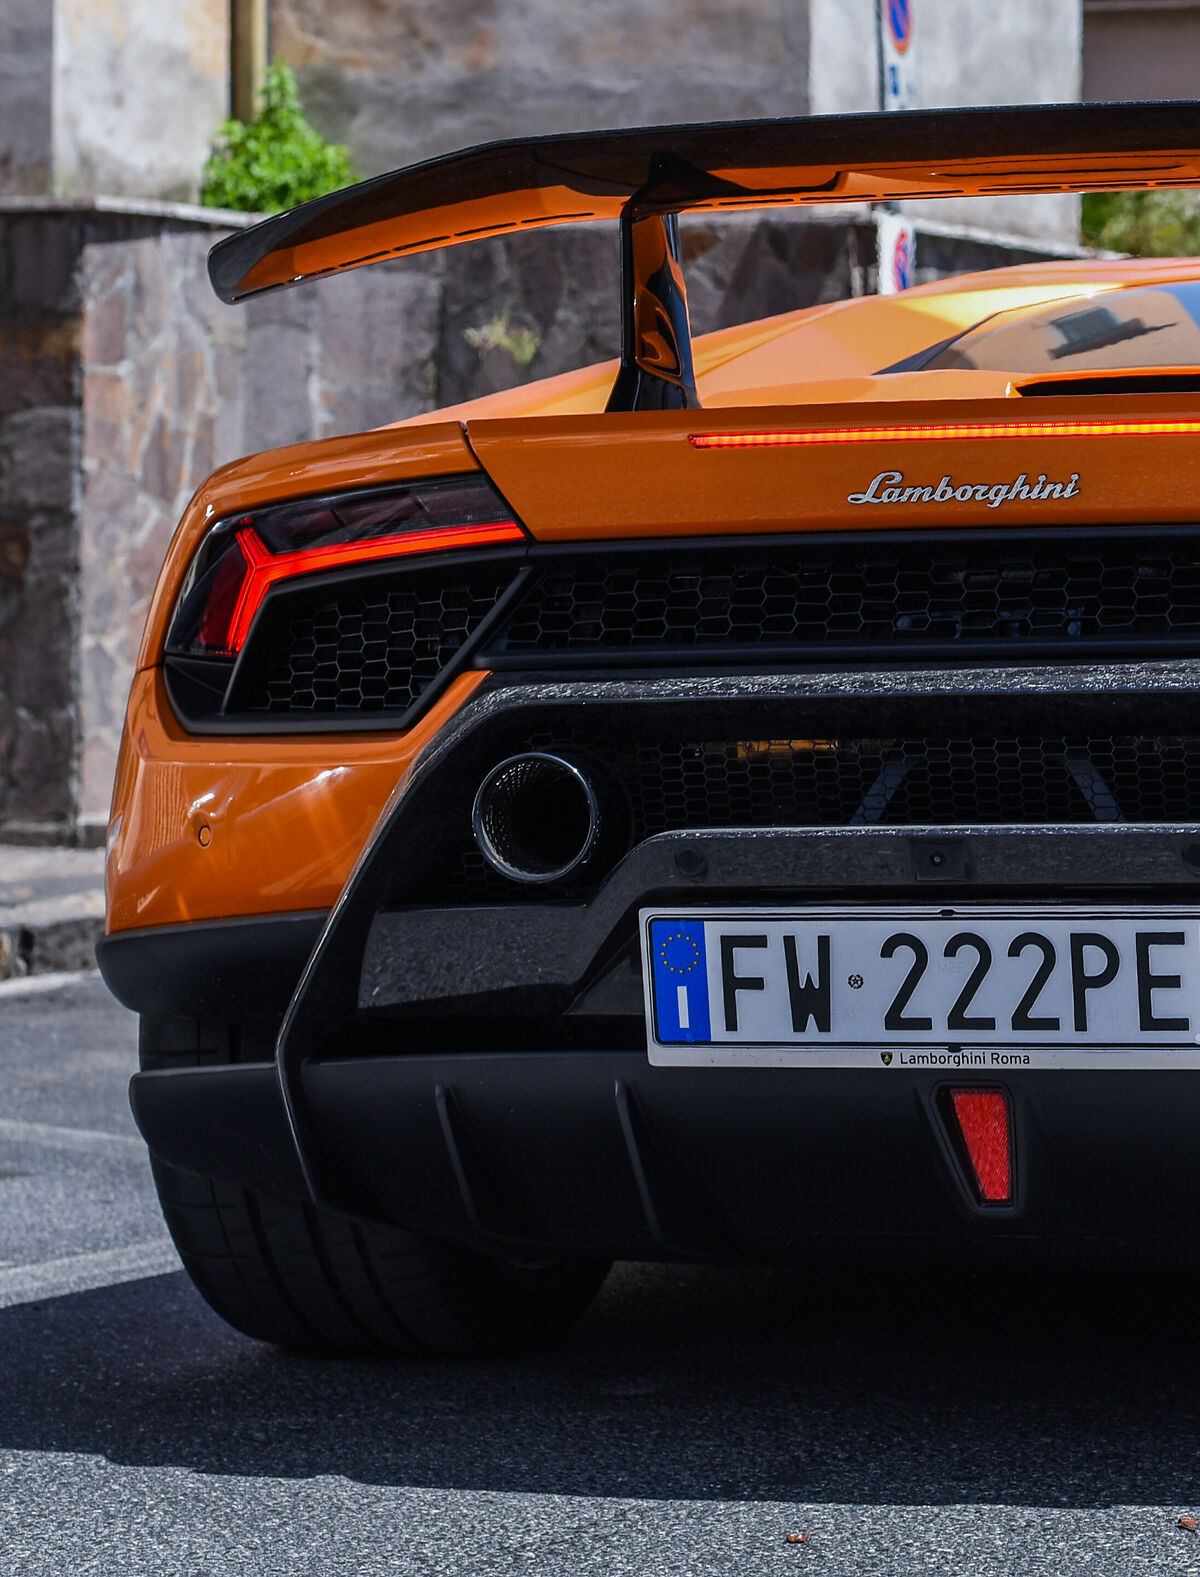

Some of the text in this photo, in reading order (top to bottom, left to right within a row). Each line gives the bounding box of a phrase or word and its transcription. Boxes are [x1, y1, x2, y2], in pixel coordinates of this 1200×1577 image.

[847, 470, 1080, 508] Lamborghini
[719, 931, 1191, 1033] FW 222PE
[899, 1050, 1031, 1067] Lamborghini Roma
